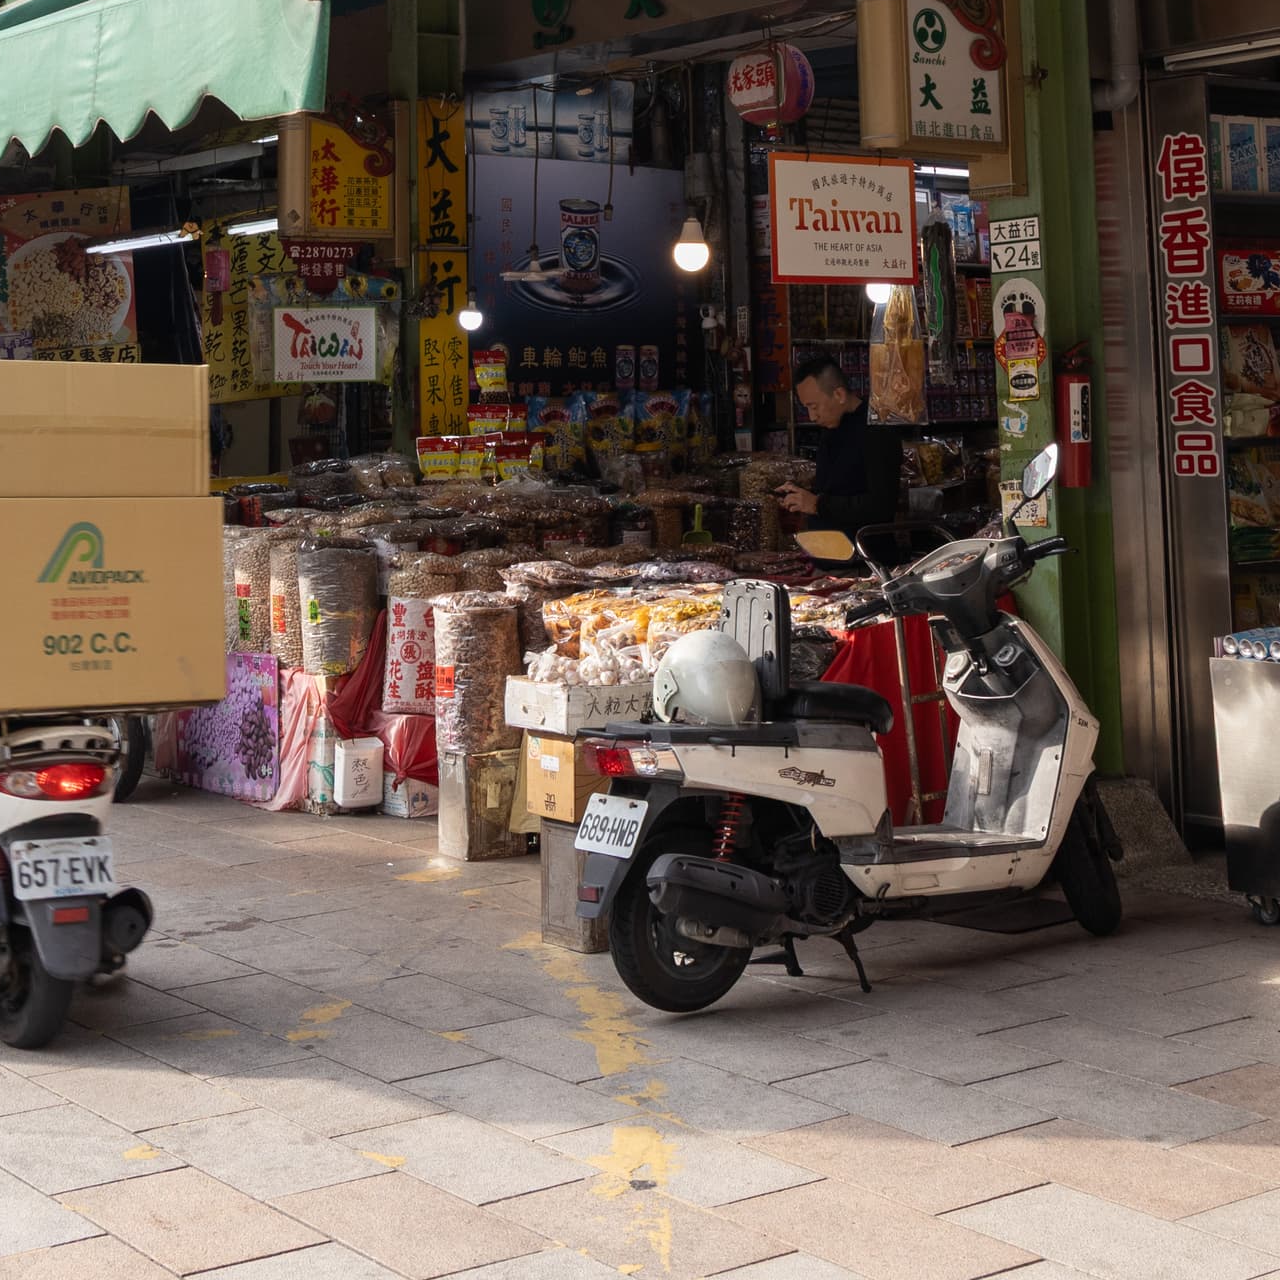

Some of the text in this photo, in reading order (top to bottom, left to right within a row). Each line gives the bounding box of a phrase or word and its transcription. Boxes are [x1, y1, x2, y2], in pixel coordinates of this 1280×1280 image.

[912, 51, 947, 66] Sanchi
[919, 73, 992, 115] 大益
[915, 120, 995, 141] 南北進口食品
[319, 139, 342, 227] 太華行
[424, 117, 460, 317] 大益行
[788, 197, 904, 234] Taiwan
[994, 220, 1037, 241] 大益行
[814, 242, 883, 253] THE HEART OF ASIA
[1004, 245, 1039, 270] 24號
[882, 258, 908, 270] 大益行
[1157, 133, 1219, 477] 偉香進口食品
[519, 344, 609, 369] 車輪鮑魚
[42, 631, 138, 655] 902 C.C.
